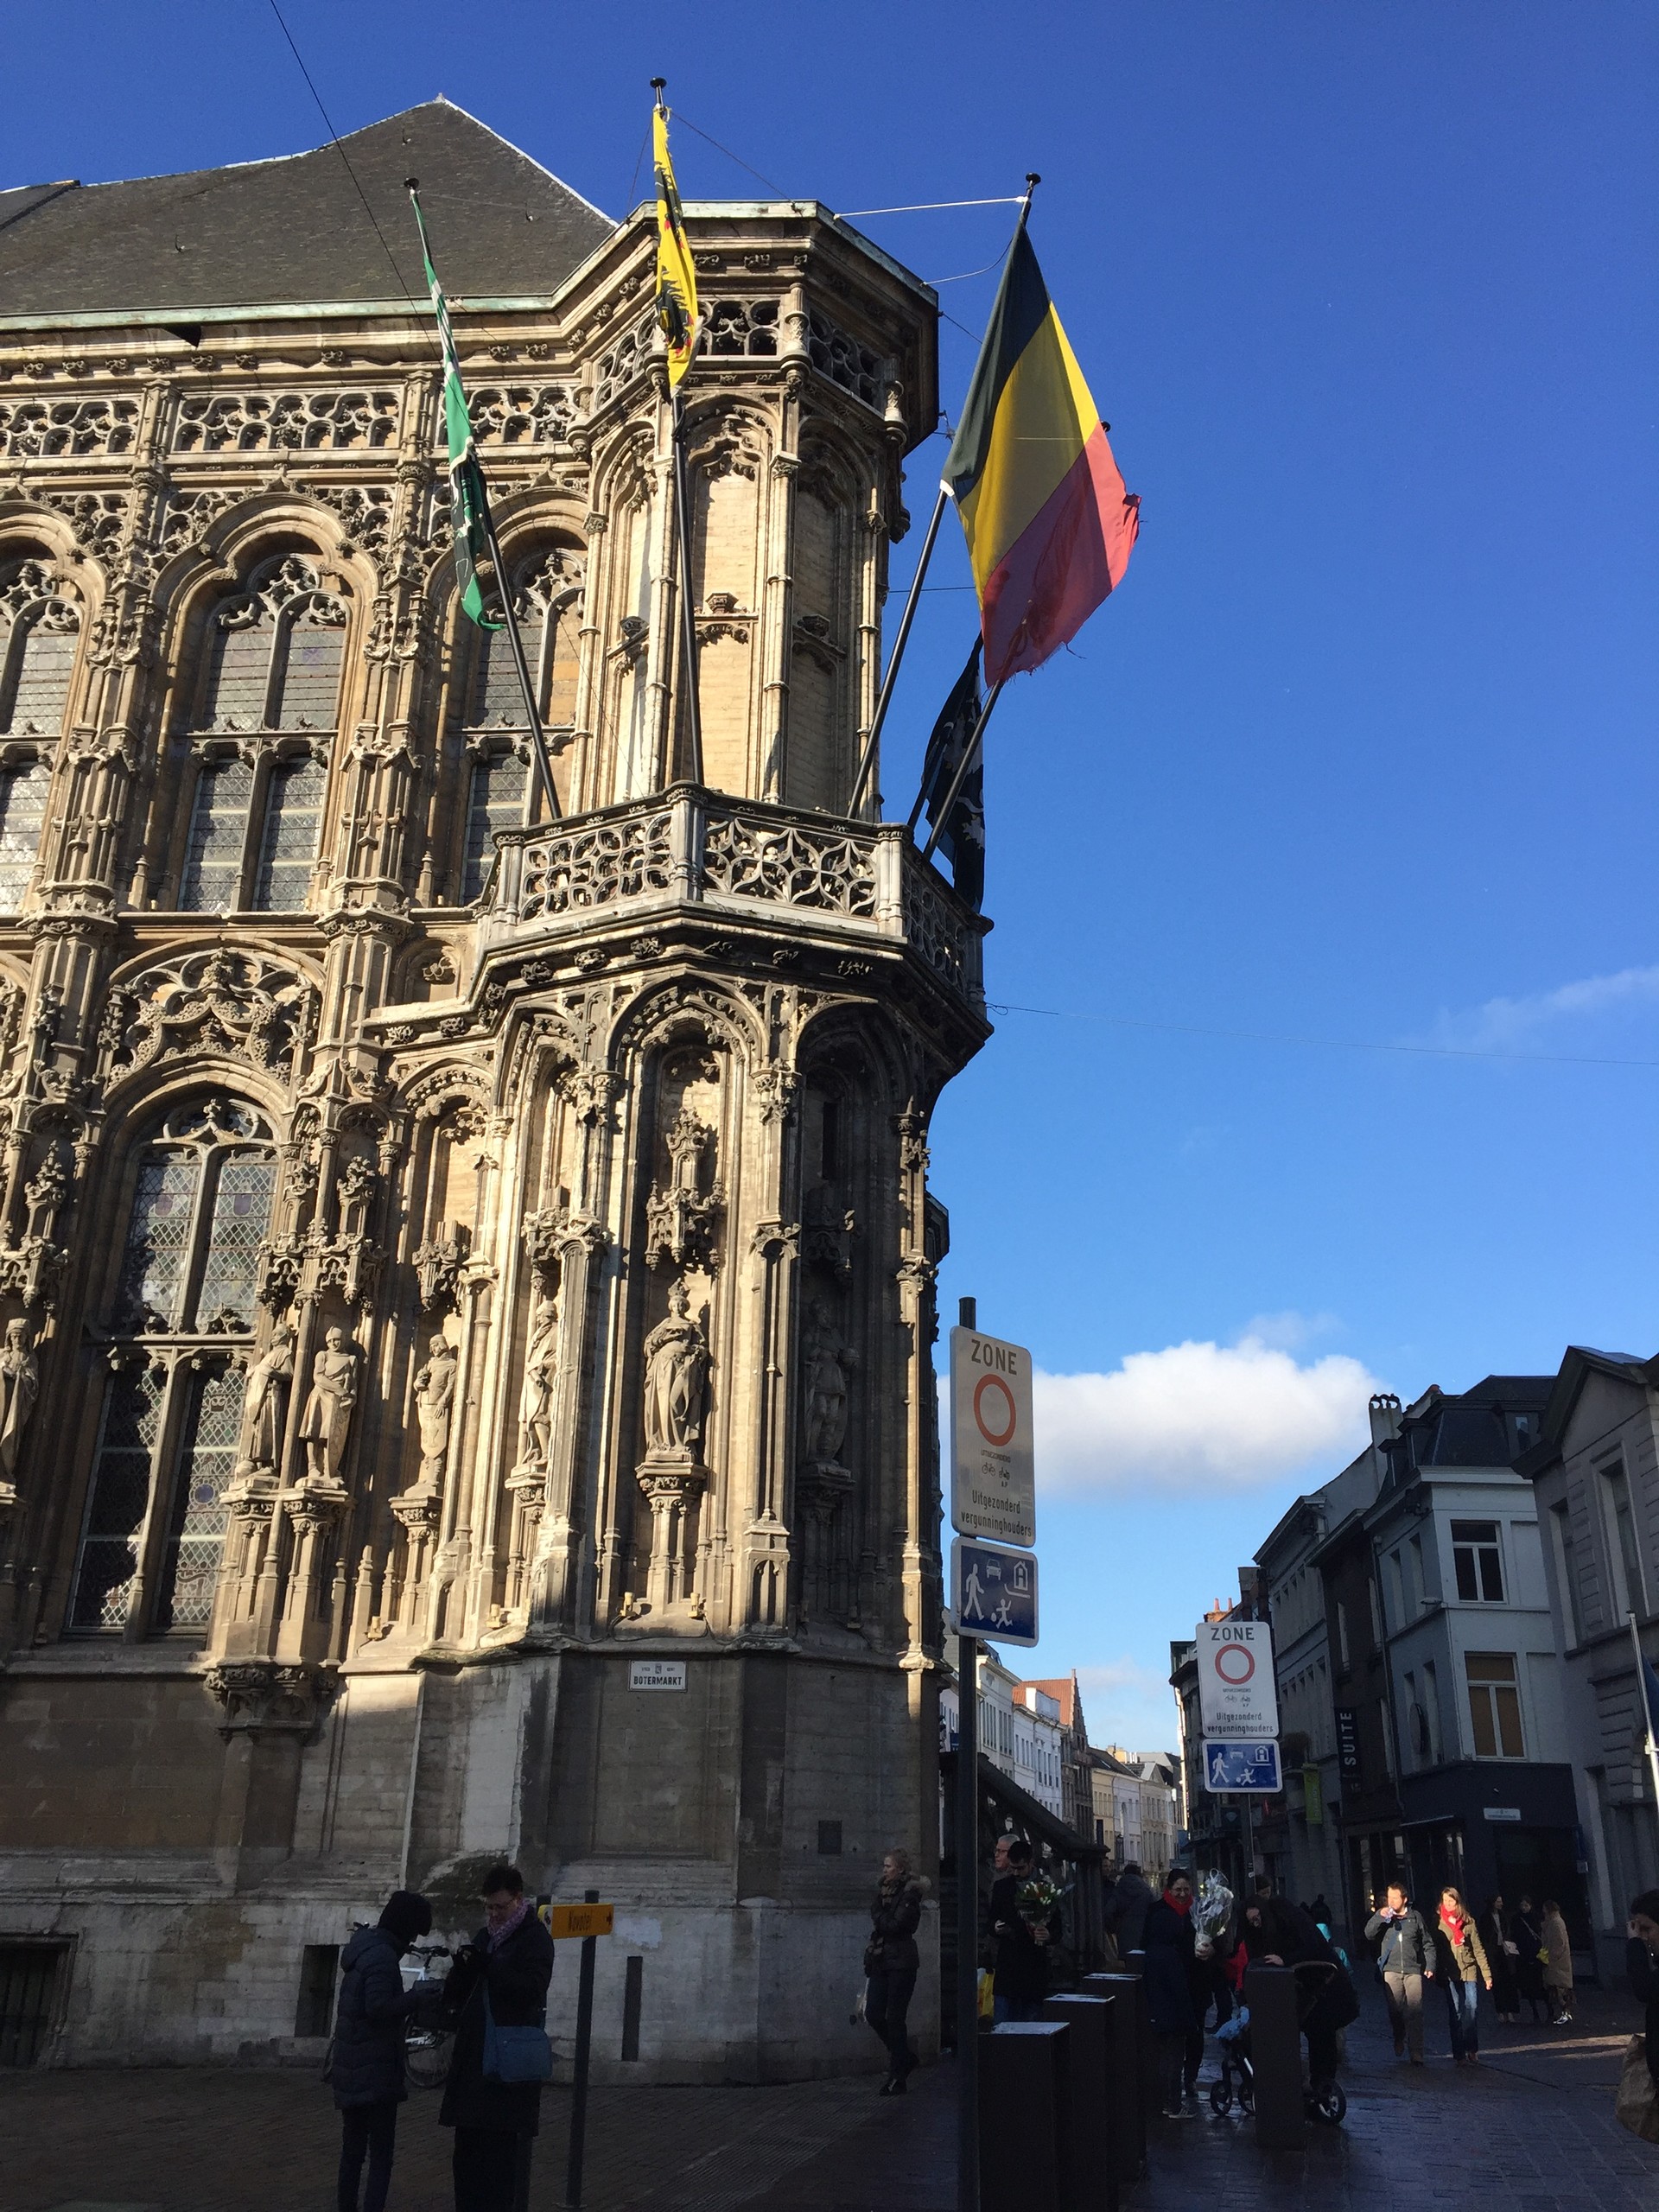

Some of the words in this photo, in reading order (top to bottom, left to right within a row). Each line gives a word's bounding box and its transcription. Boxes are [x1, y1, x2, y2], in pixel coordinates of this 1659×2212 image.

[971, 1338, 1017, 1376] ZONE
[972, 1490, 1020, 1514] Uitgezonderd
[961, 1511, 1032, 1536] vergunninghouders
[1211, 1627, 1255, 1641] ZONE
[633, 1675, 682, 1685] BOTERMARKT
[1216, 1712, 1262, 1722] Uitgezonderd
[1207, 1725, 1274, 1734] vergunninghouders
[1340, 1713, 1357, 1765] SUITE
